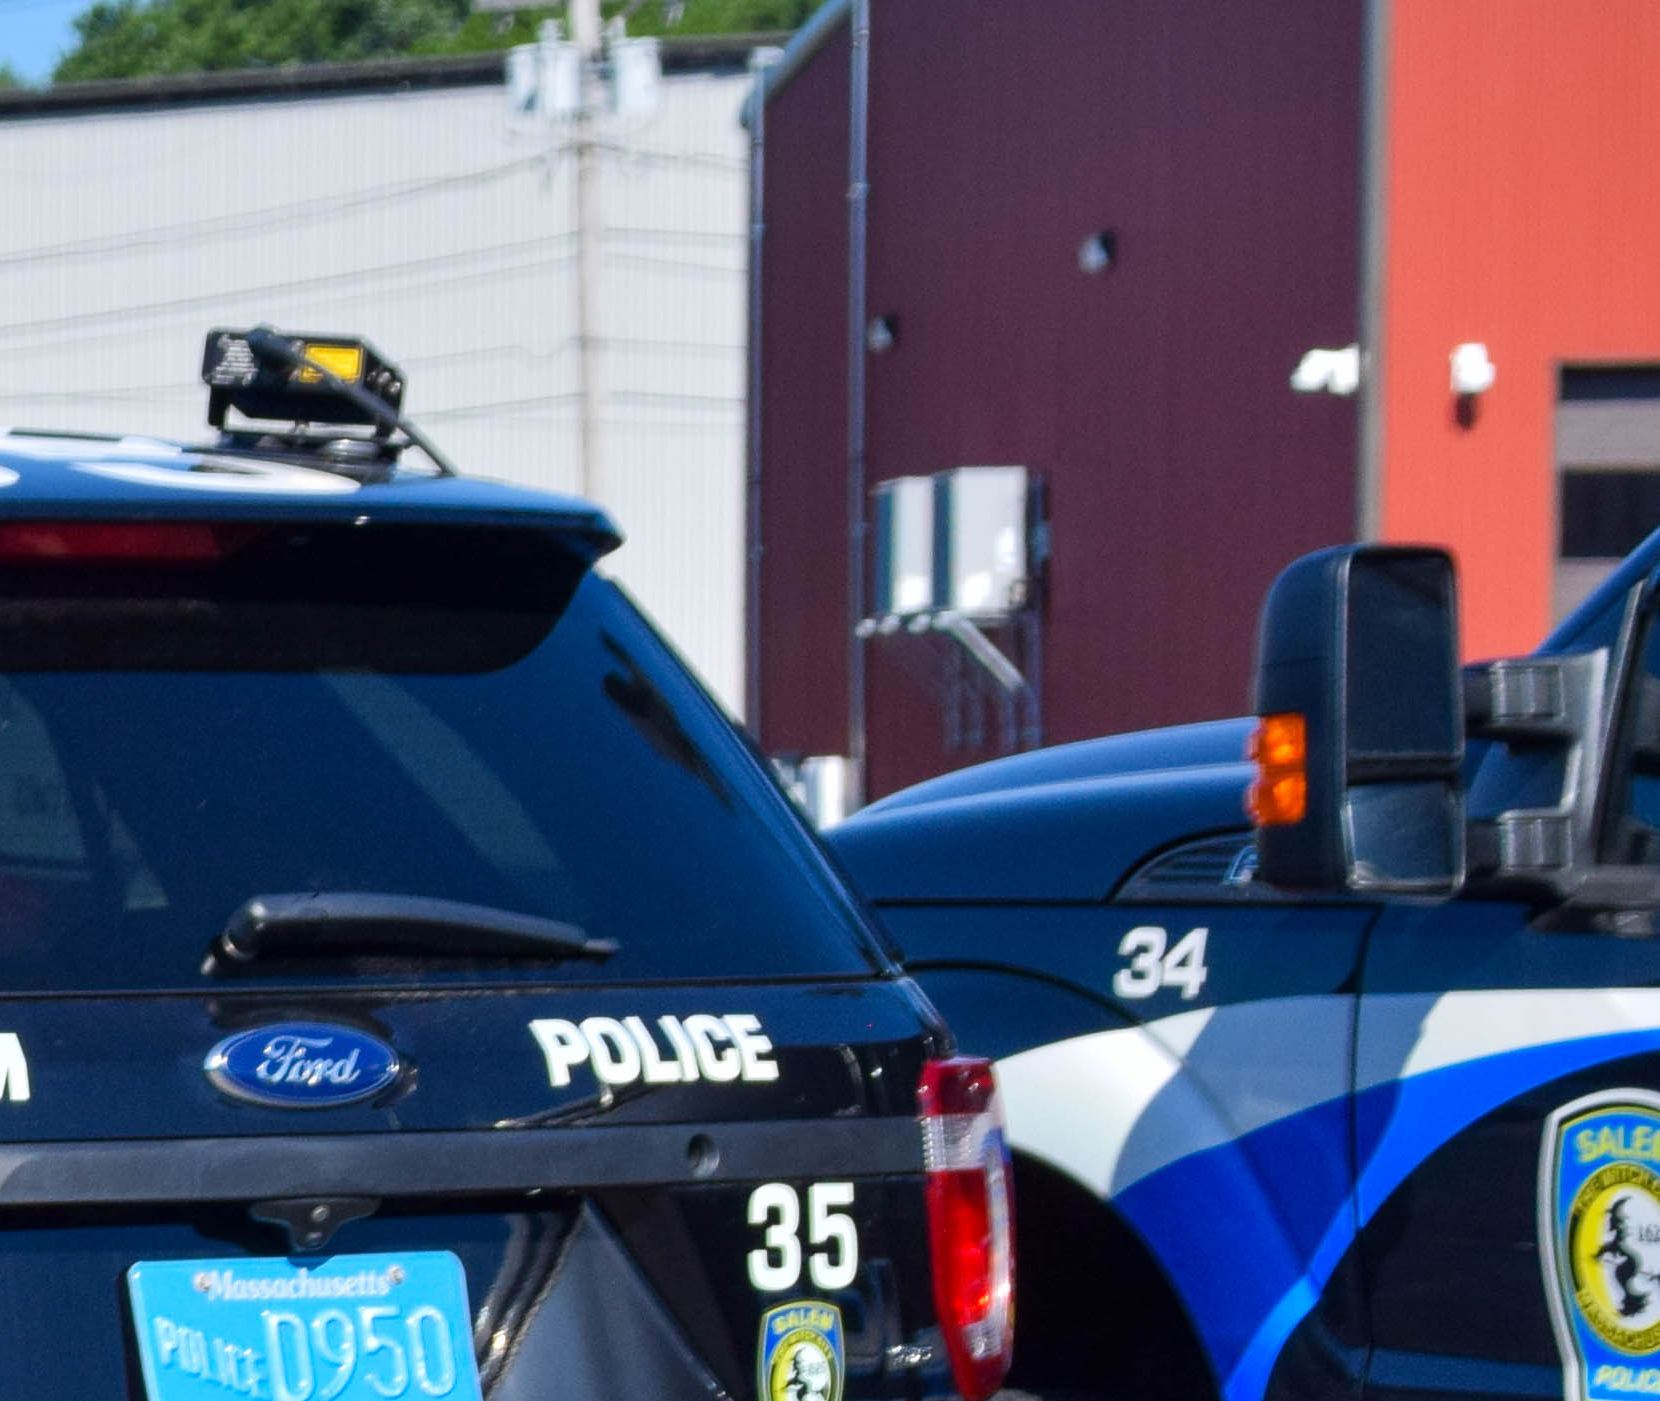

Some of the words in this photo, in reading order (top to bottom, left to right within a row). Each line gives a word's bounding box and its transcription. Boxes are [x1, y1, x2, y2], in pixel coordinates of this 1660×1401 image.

[1113, 926, 1209, 999] 34
[256, 1035, 361, 1086] Ford
[528, 1013, 780, 1090] POLICE
[746, 1182, 859, 1291] 35
[207, 1269, 392, 1301] Massachusetts
[153, 1316, 271, 1401] POLICE
[1595, 1365, 1660, 1392] POLIC
